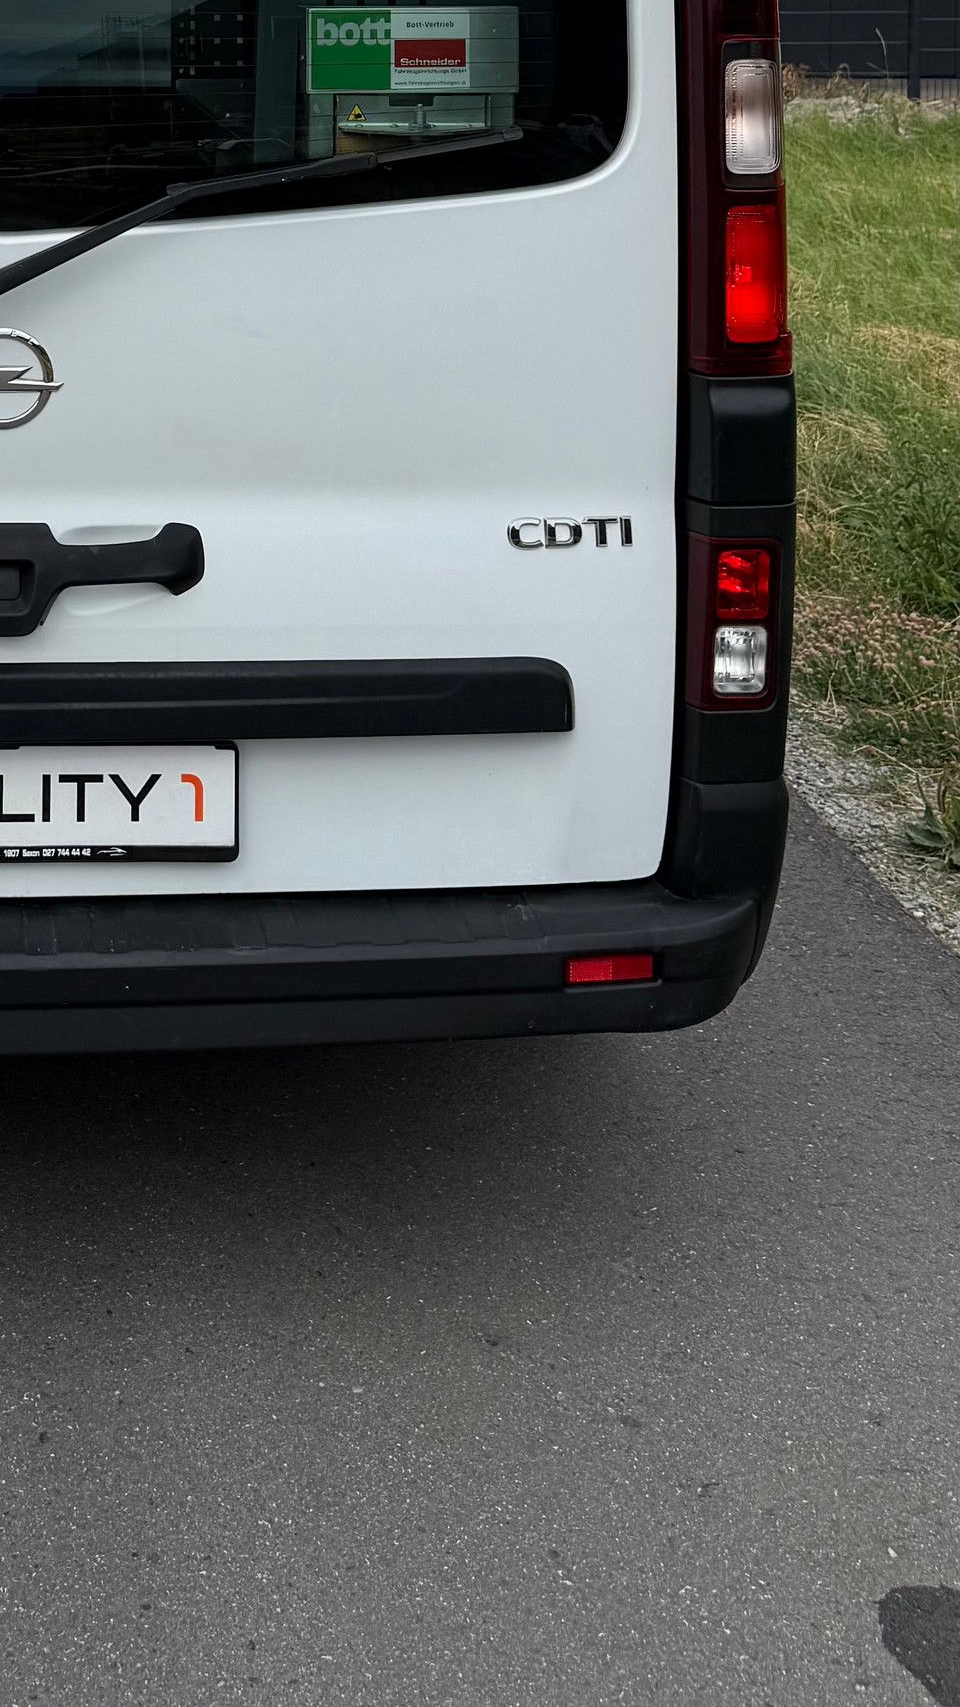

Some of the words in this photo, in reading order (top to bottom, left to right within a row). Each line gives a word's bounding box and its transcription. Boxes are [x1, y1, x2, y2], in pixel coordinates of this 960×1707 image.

[316, 17, 392, 46] bott
[400, 57, 461, 66] Schneider
[506, 515, 634, 551] CDTI
[180, 772, 205, 822] 1
[3, 848, 20, 857] 1907
[42, 848, 55, 857] 027
[57, 848, 70, 857] 744
[71, 847, 81, 856] 44
[81, 847, 91, 856] 42
